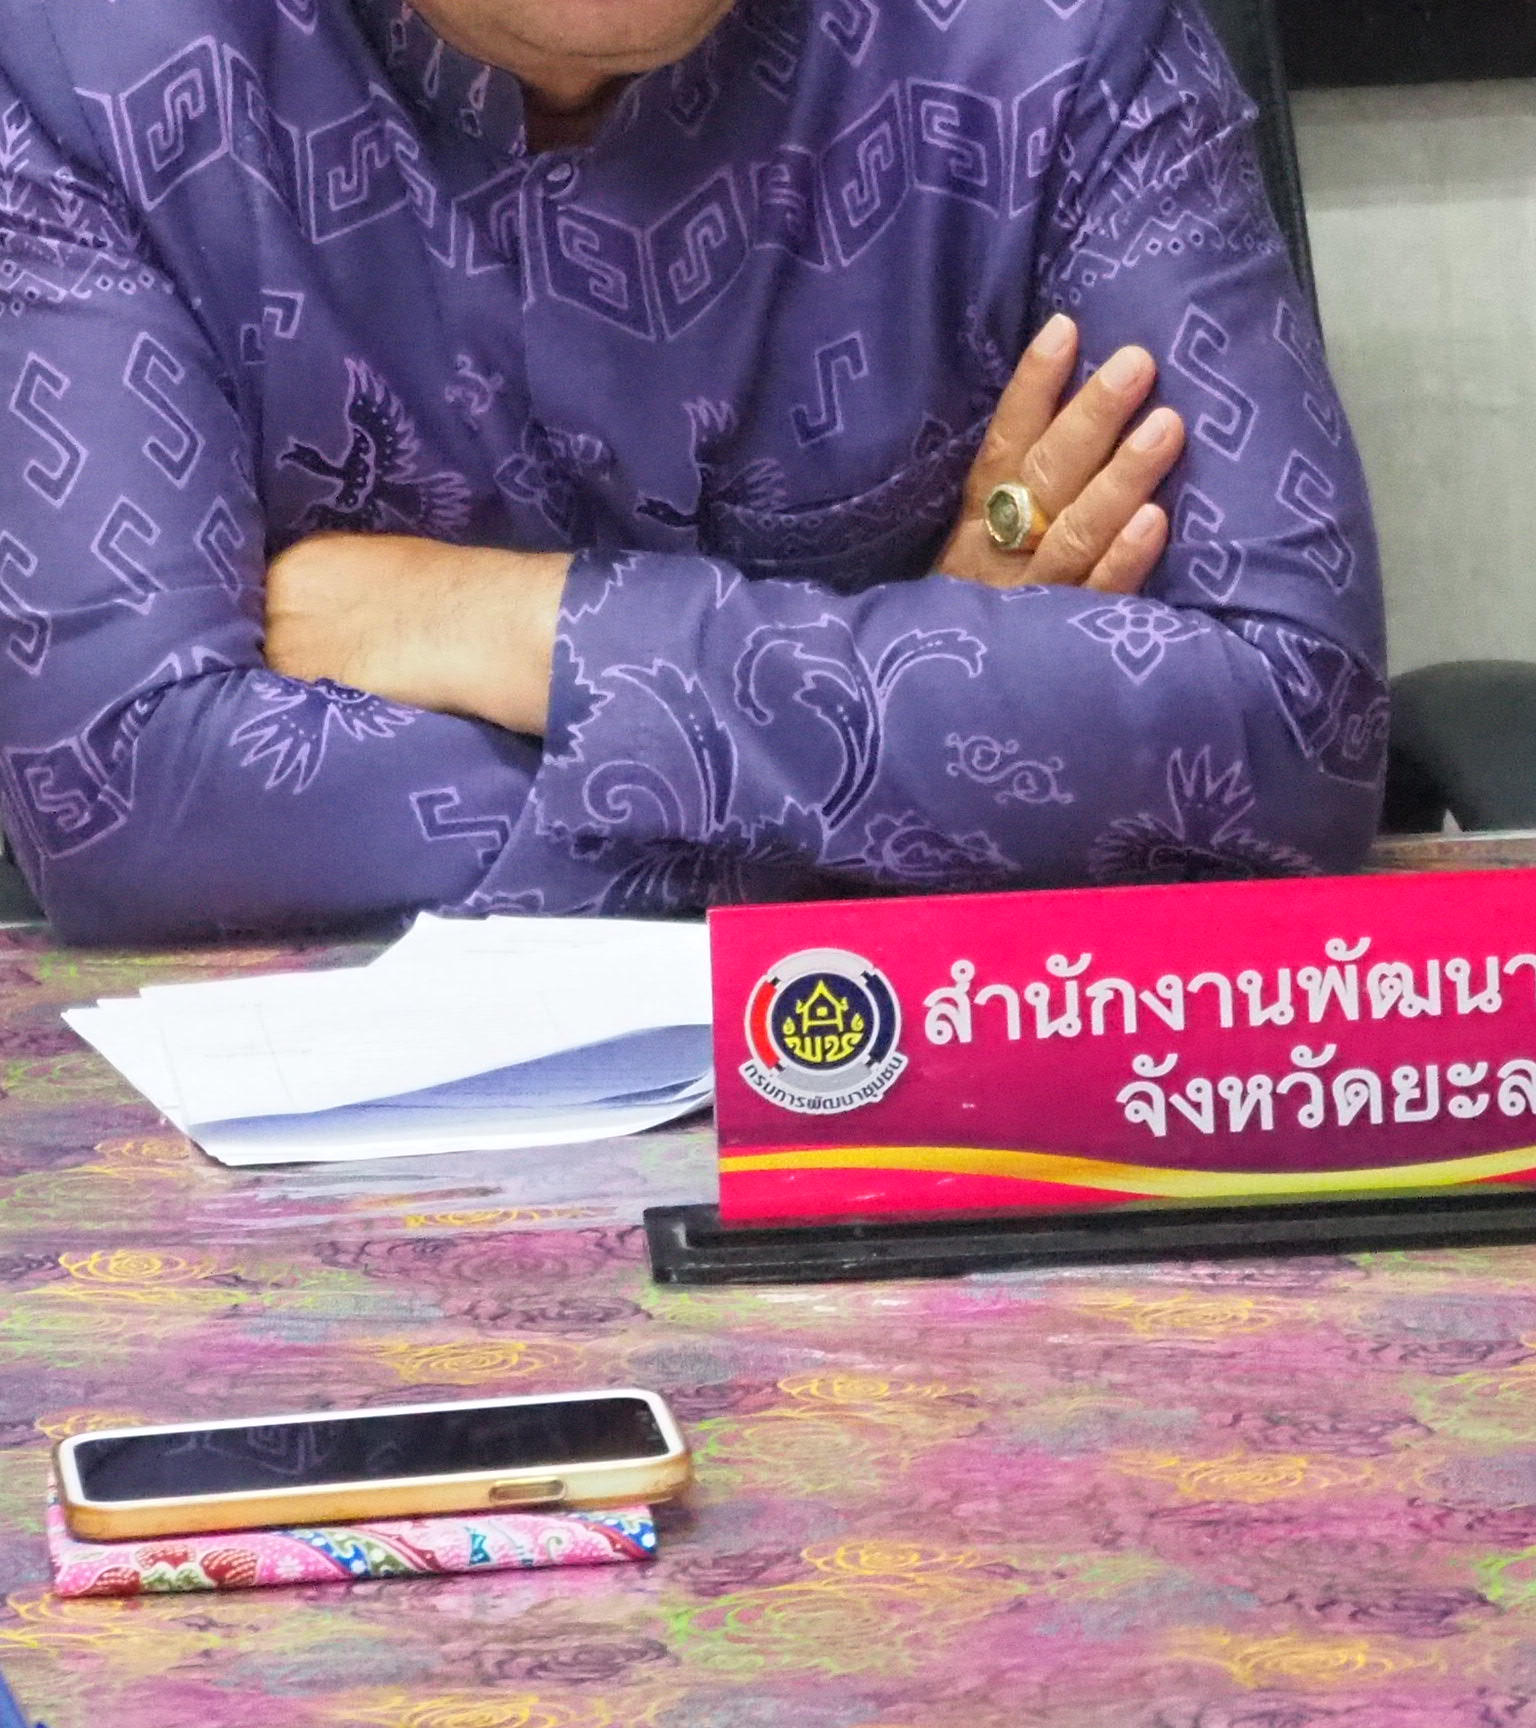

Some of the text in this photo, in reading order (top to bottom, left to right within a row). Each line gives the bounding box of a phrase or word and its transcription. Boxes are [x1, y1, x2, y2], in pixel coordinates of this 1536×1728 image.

[744, 1054, 903, 1111] กรมการพัฒนาชุมชน
